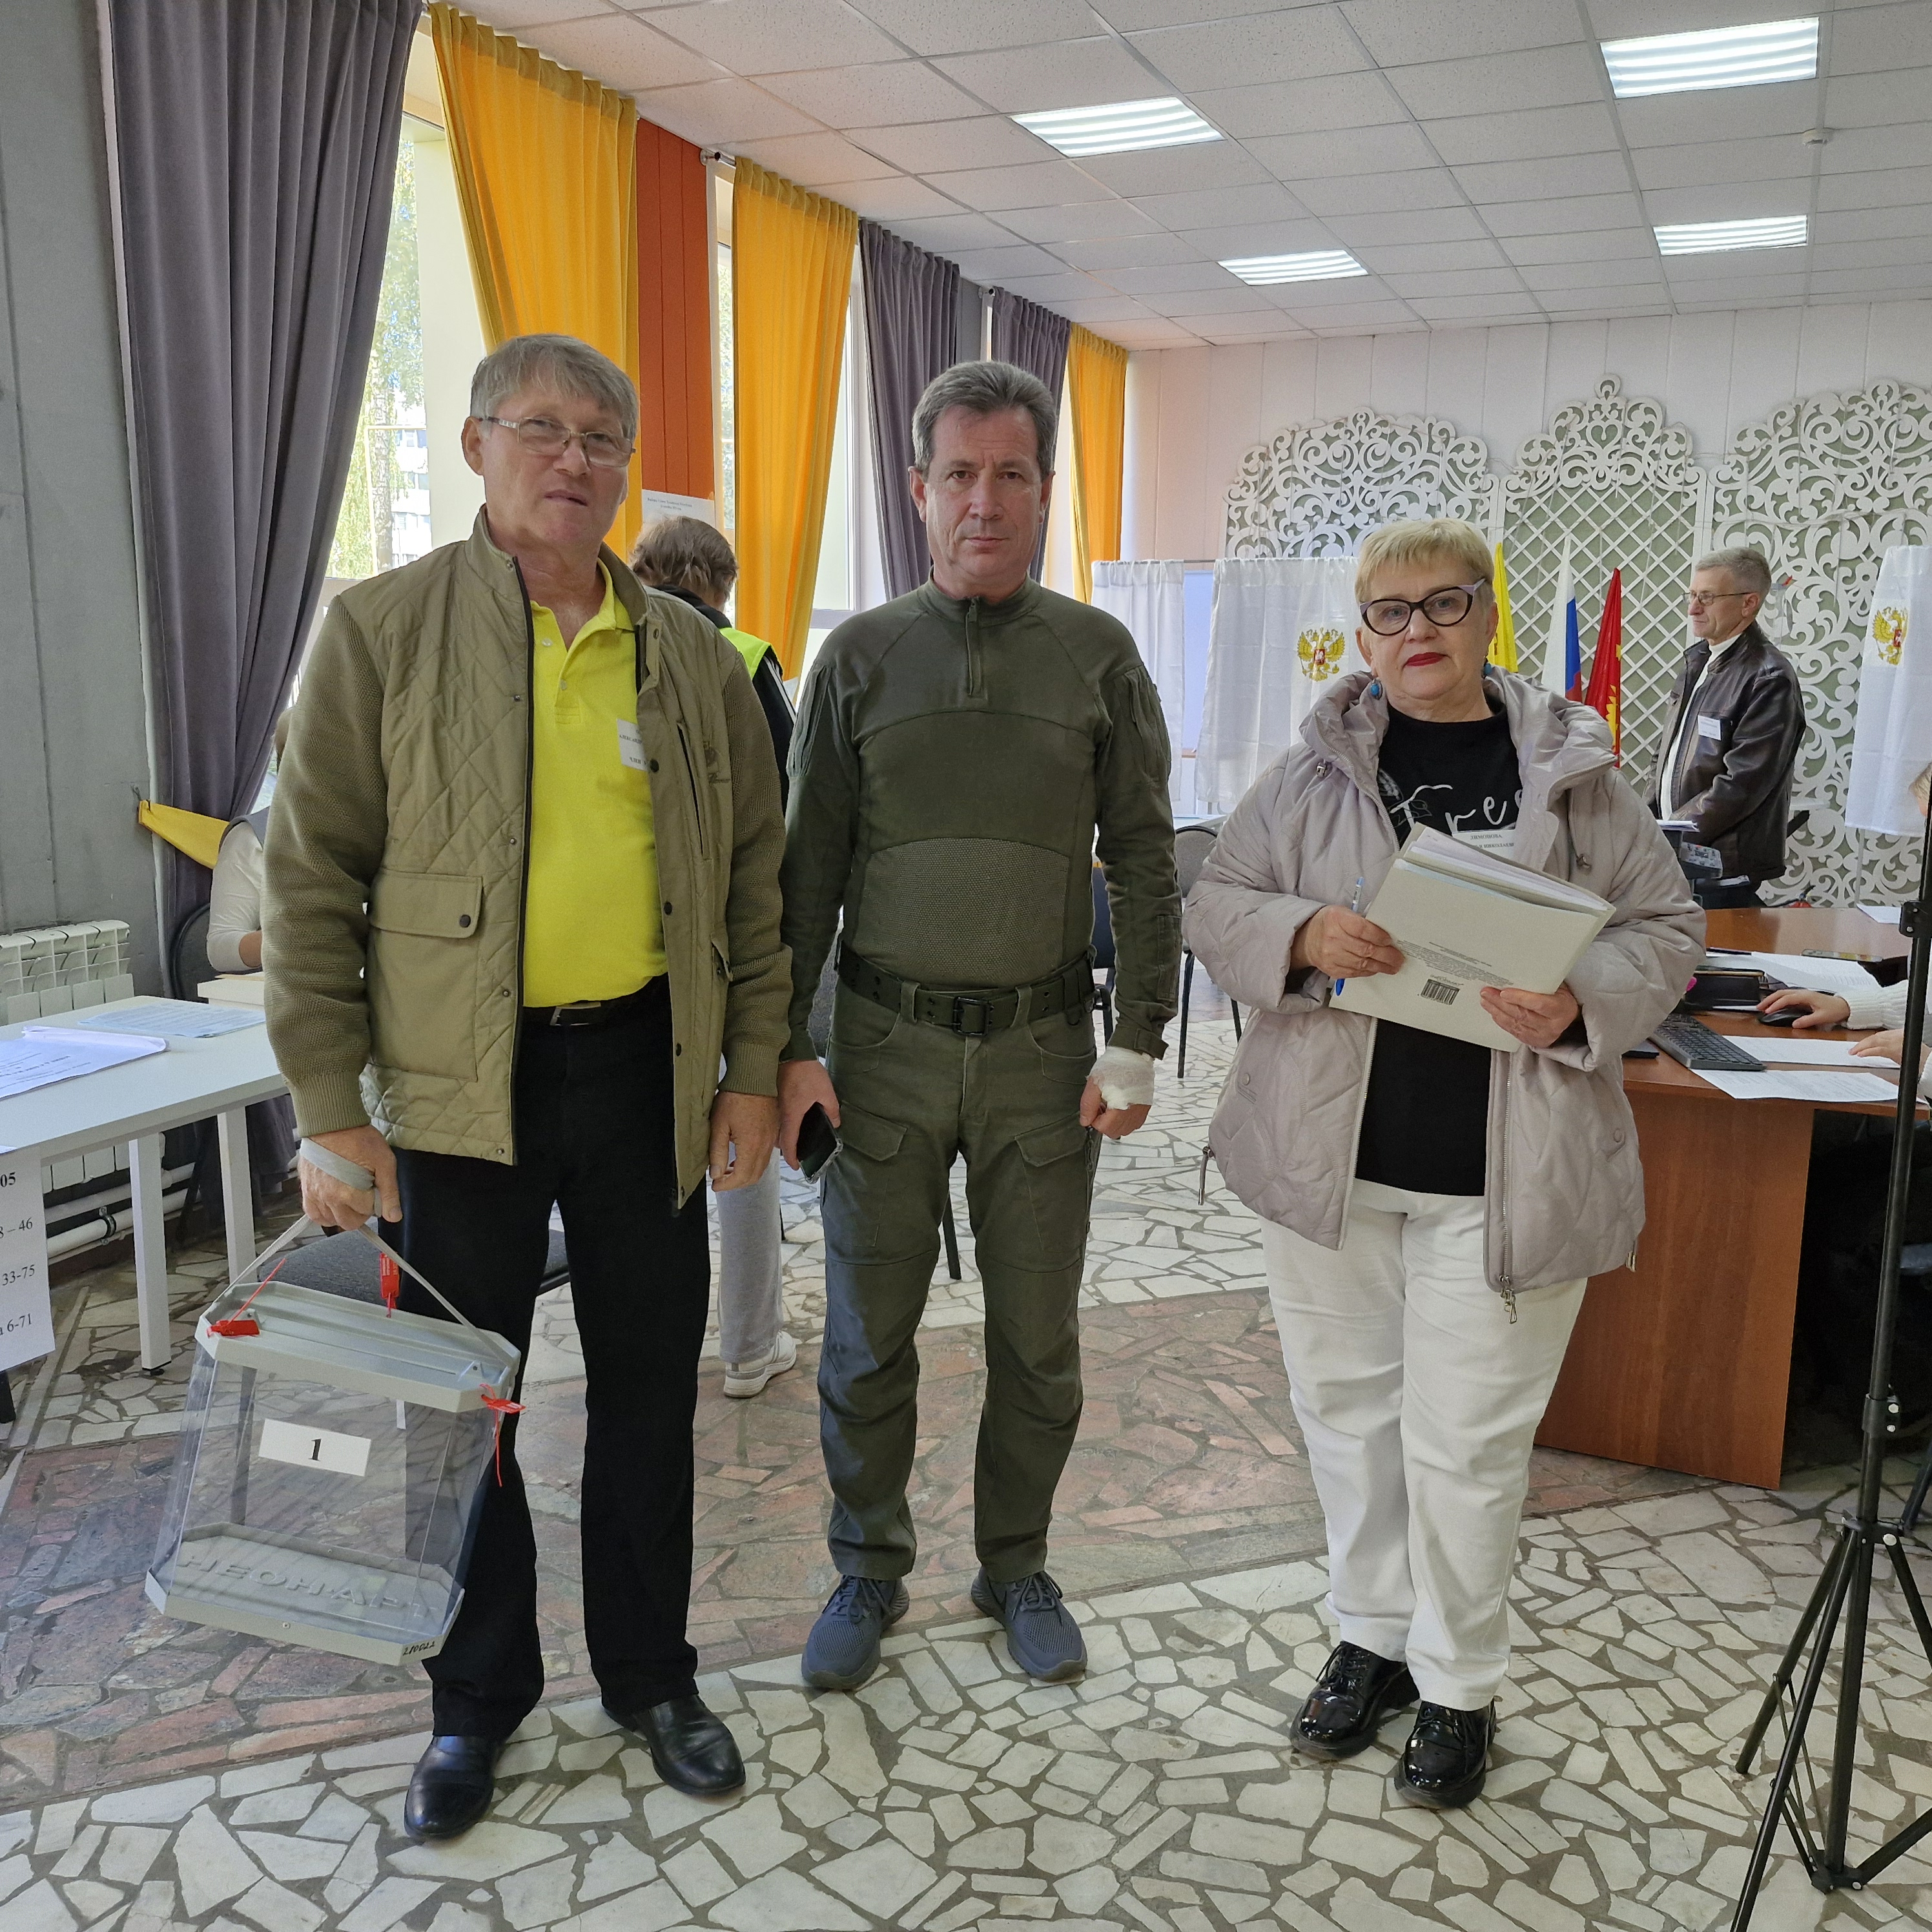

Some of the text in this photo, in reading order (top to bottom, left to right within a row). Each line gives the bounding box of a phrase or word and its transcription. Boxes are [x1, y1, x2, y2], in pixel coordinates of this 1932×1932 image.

[19, 1217, 33, 1231] 46
[2, 1264, 35, 1286] 33-75
[7, 1313, 32, 1332] 6-71
[308, 1438, 322, 1461] 1
